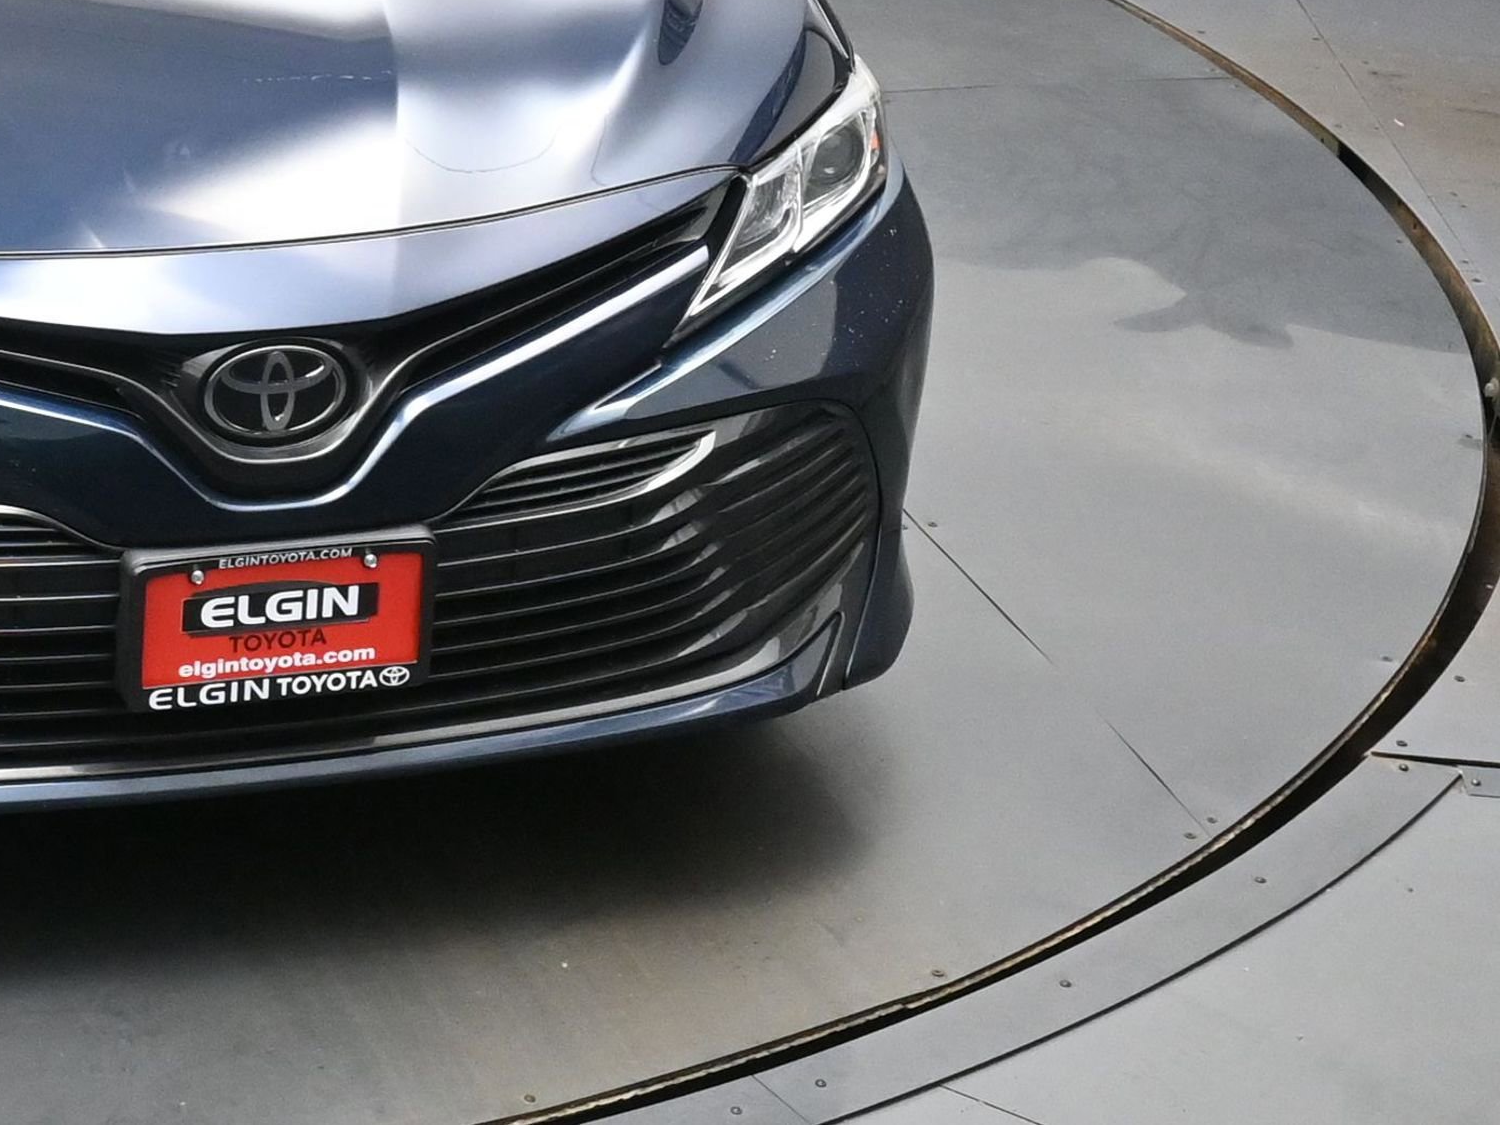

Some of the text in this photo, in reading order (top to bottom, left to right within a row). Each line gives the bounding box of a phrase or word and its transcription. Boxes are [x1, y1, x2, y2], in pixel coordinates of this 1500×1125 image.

[219, 548, 352, 569] ELGINTOYOTA.COM
[200, 585, 359, 628] ELGIN
[229, 628, 327, 653] TOYOTA
[178, 647, 375, 678] elgintoyota.com
[148, 670, 378, 710] ELGIN TOYOTA
